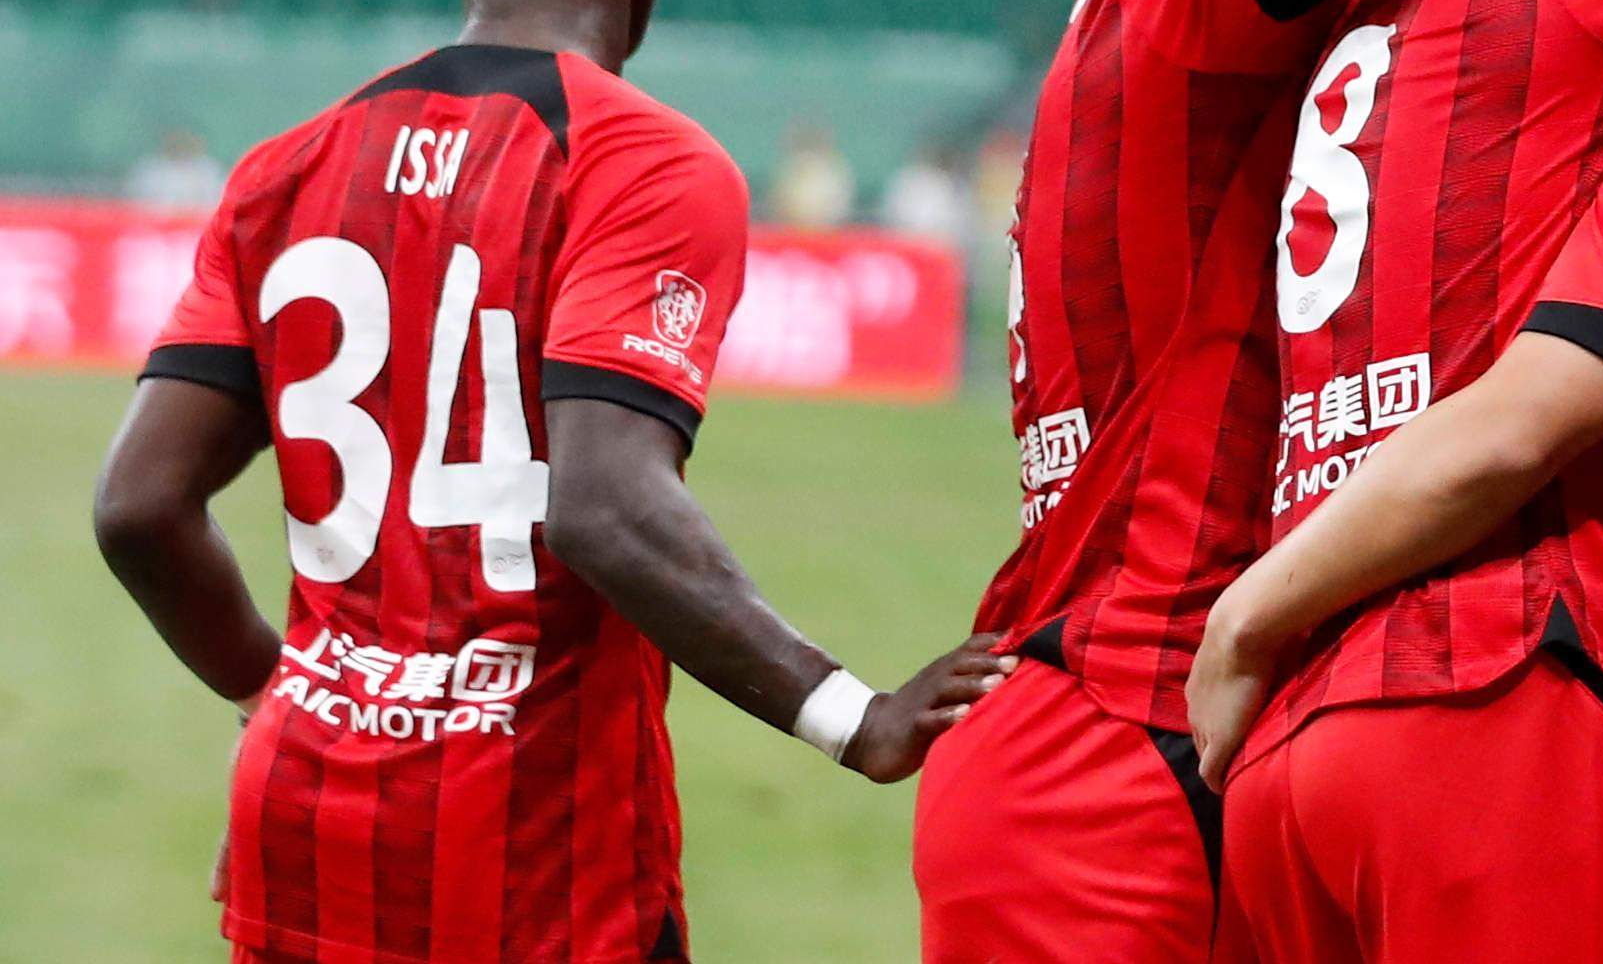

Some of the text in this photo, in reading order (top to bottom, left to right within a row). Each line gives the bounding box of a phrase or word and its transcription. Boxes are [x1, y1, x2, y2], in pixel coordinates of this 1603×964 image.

[385, 125, 469, 199] ISSA
[1277, 22, 1397, 334] 8
[259, 236, 550, 592] 34
[1275, 352, 1431, 476] 汽集团
[272, 666, 516, 742] AIC MOTOR
[281, 627, 537, 702] 上汽集团
